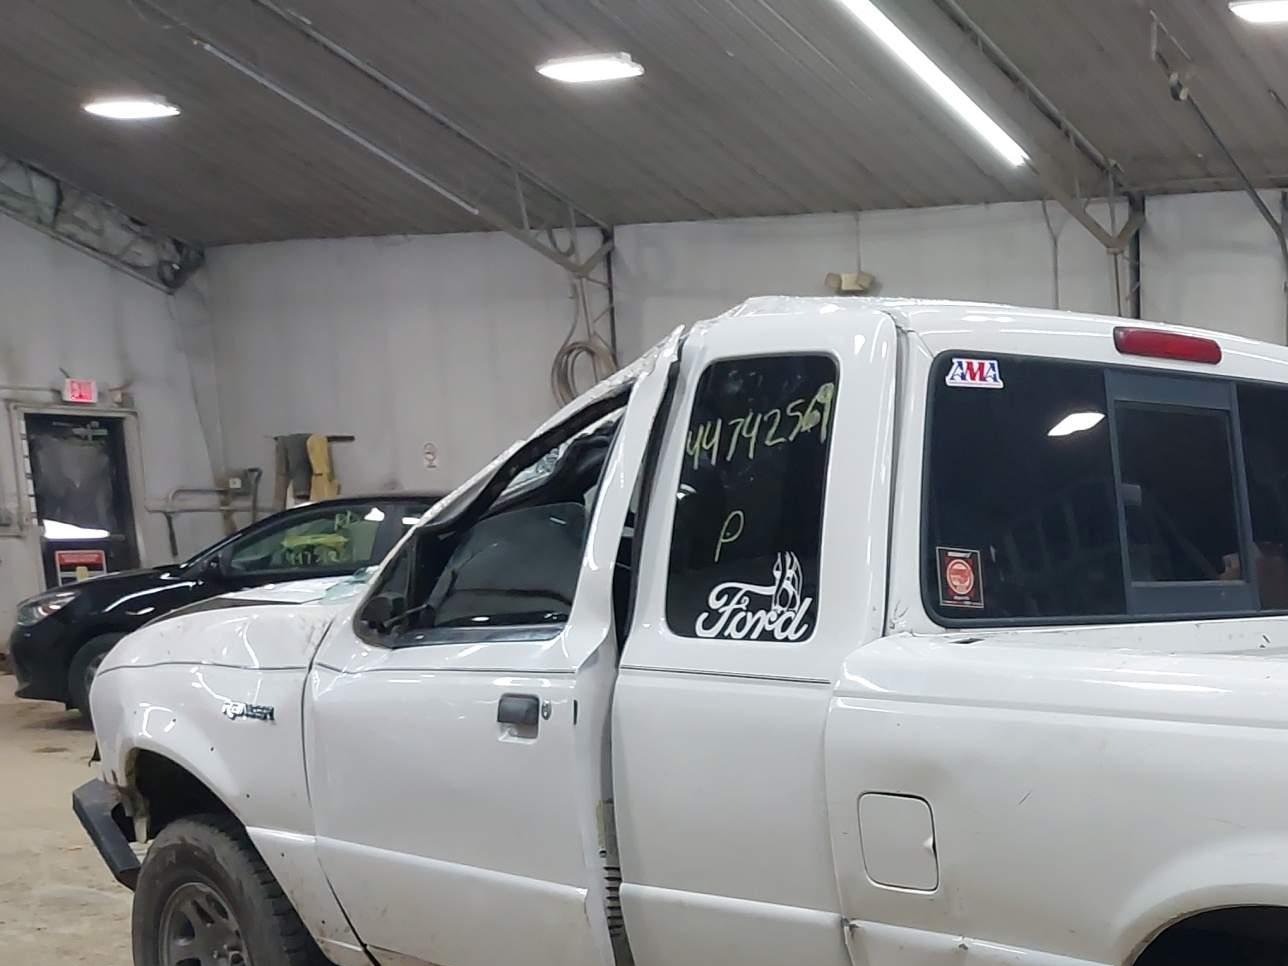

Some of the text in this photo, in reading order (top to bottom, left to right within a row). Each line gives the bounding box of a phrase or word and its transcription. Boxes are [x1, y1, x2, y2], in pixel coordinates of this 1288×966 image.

[950, 360, 999, 383] AMA
[685, 382, 836, 470] 44742569
[714, 510, 744, 562] P
[695, 578, 813, 641] Ford
